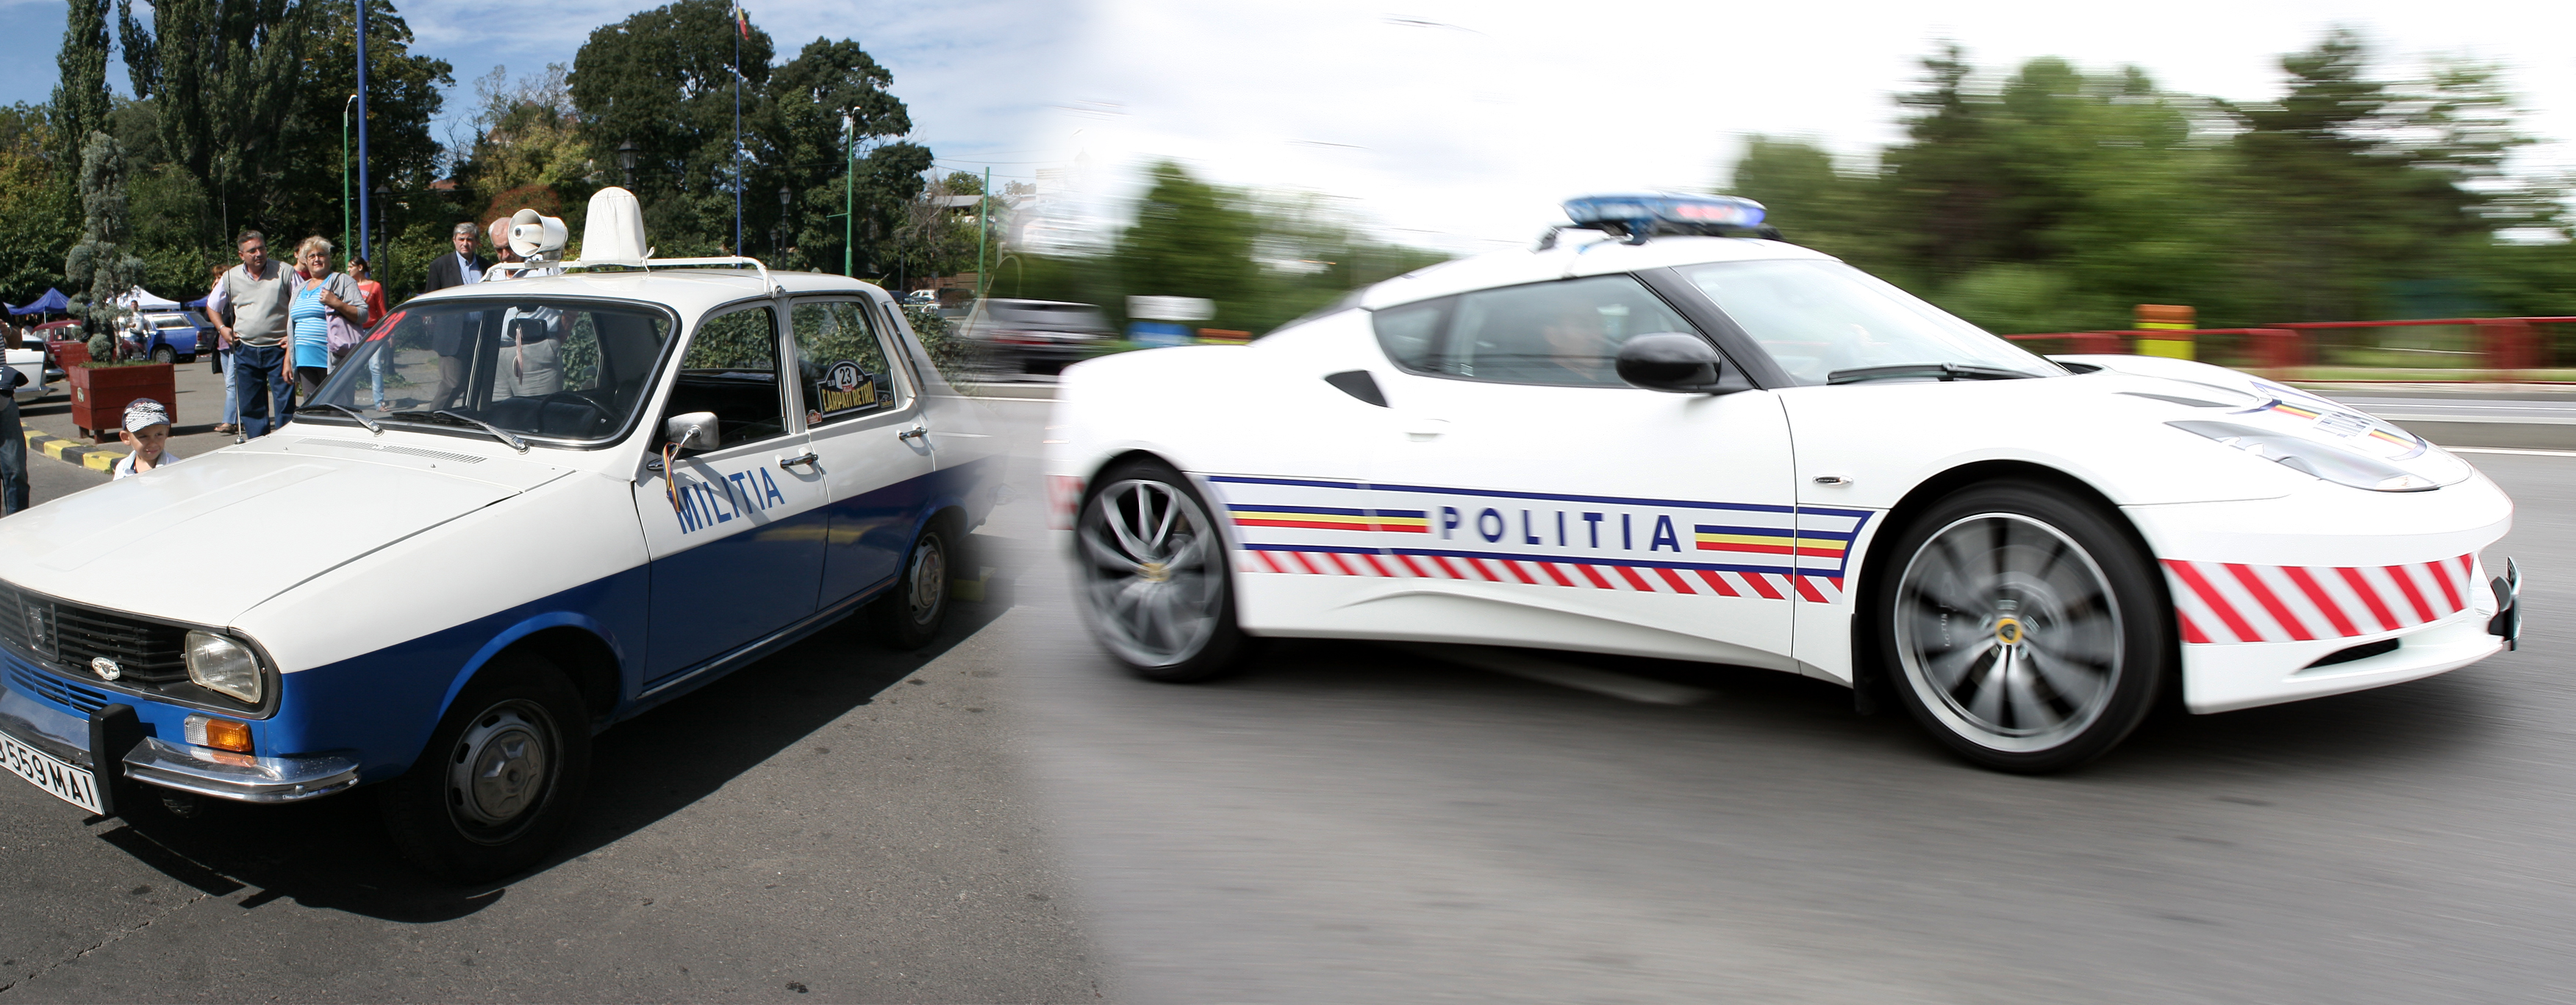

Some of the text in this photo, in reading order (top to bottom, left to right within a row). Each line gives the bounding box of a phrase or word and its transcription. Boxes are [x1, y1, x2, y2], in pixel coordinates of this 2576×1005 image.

[365, 311, 407, 343] 23
[840, 368, 851, 384] 23
[822, 380, 875, 412] CARPATI RETRO
[668, 466, 785, 534] MILITIA
[1439, 506, 1681, 553] POLITIA
[47, 761, 96, 807] MAI
